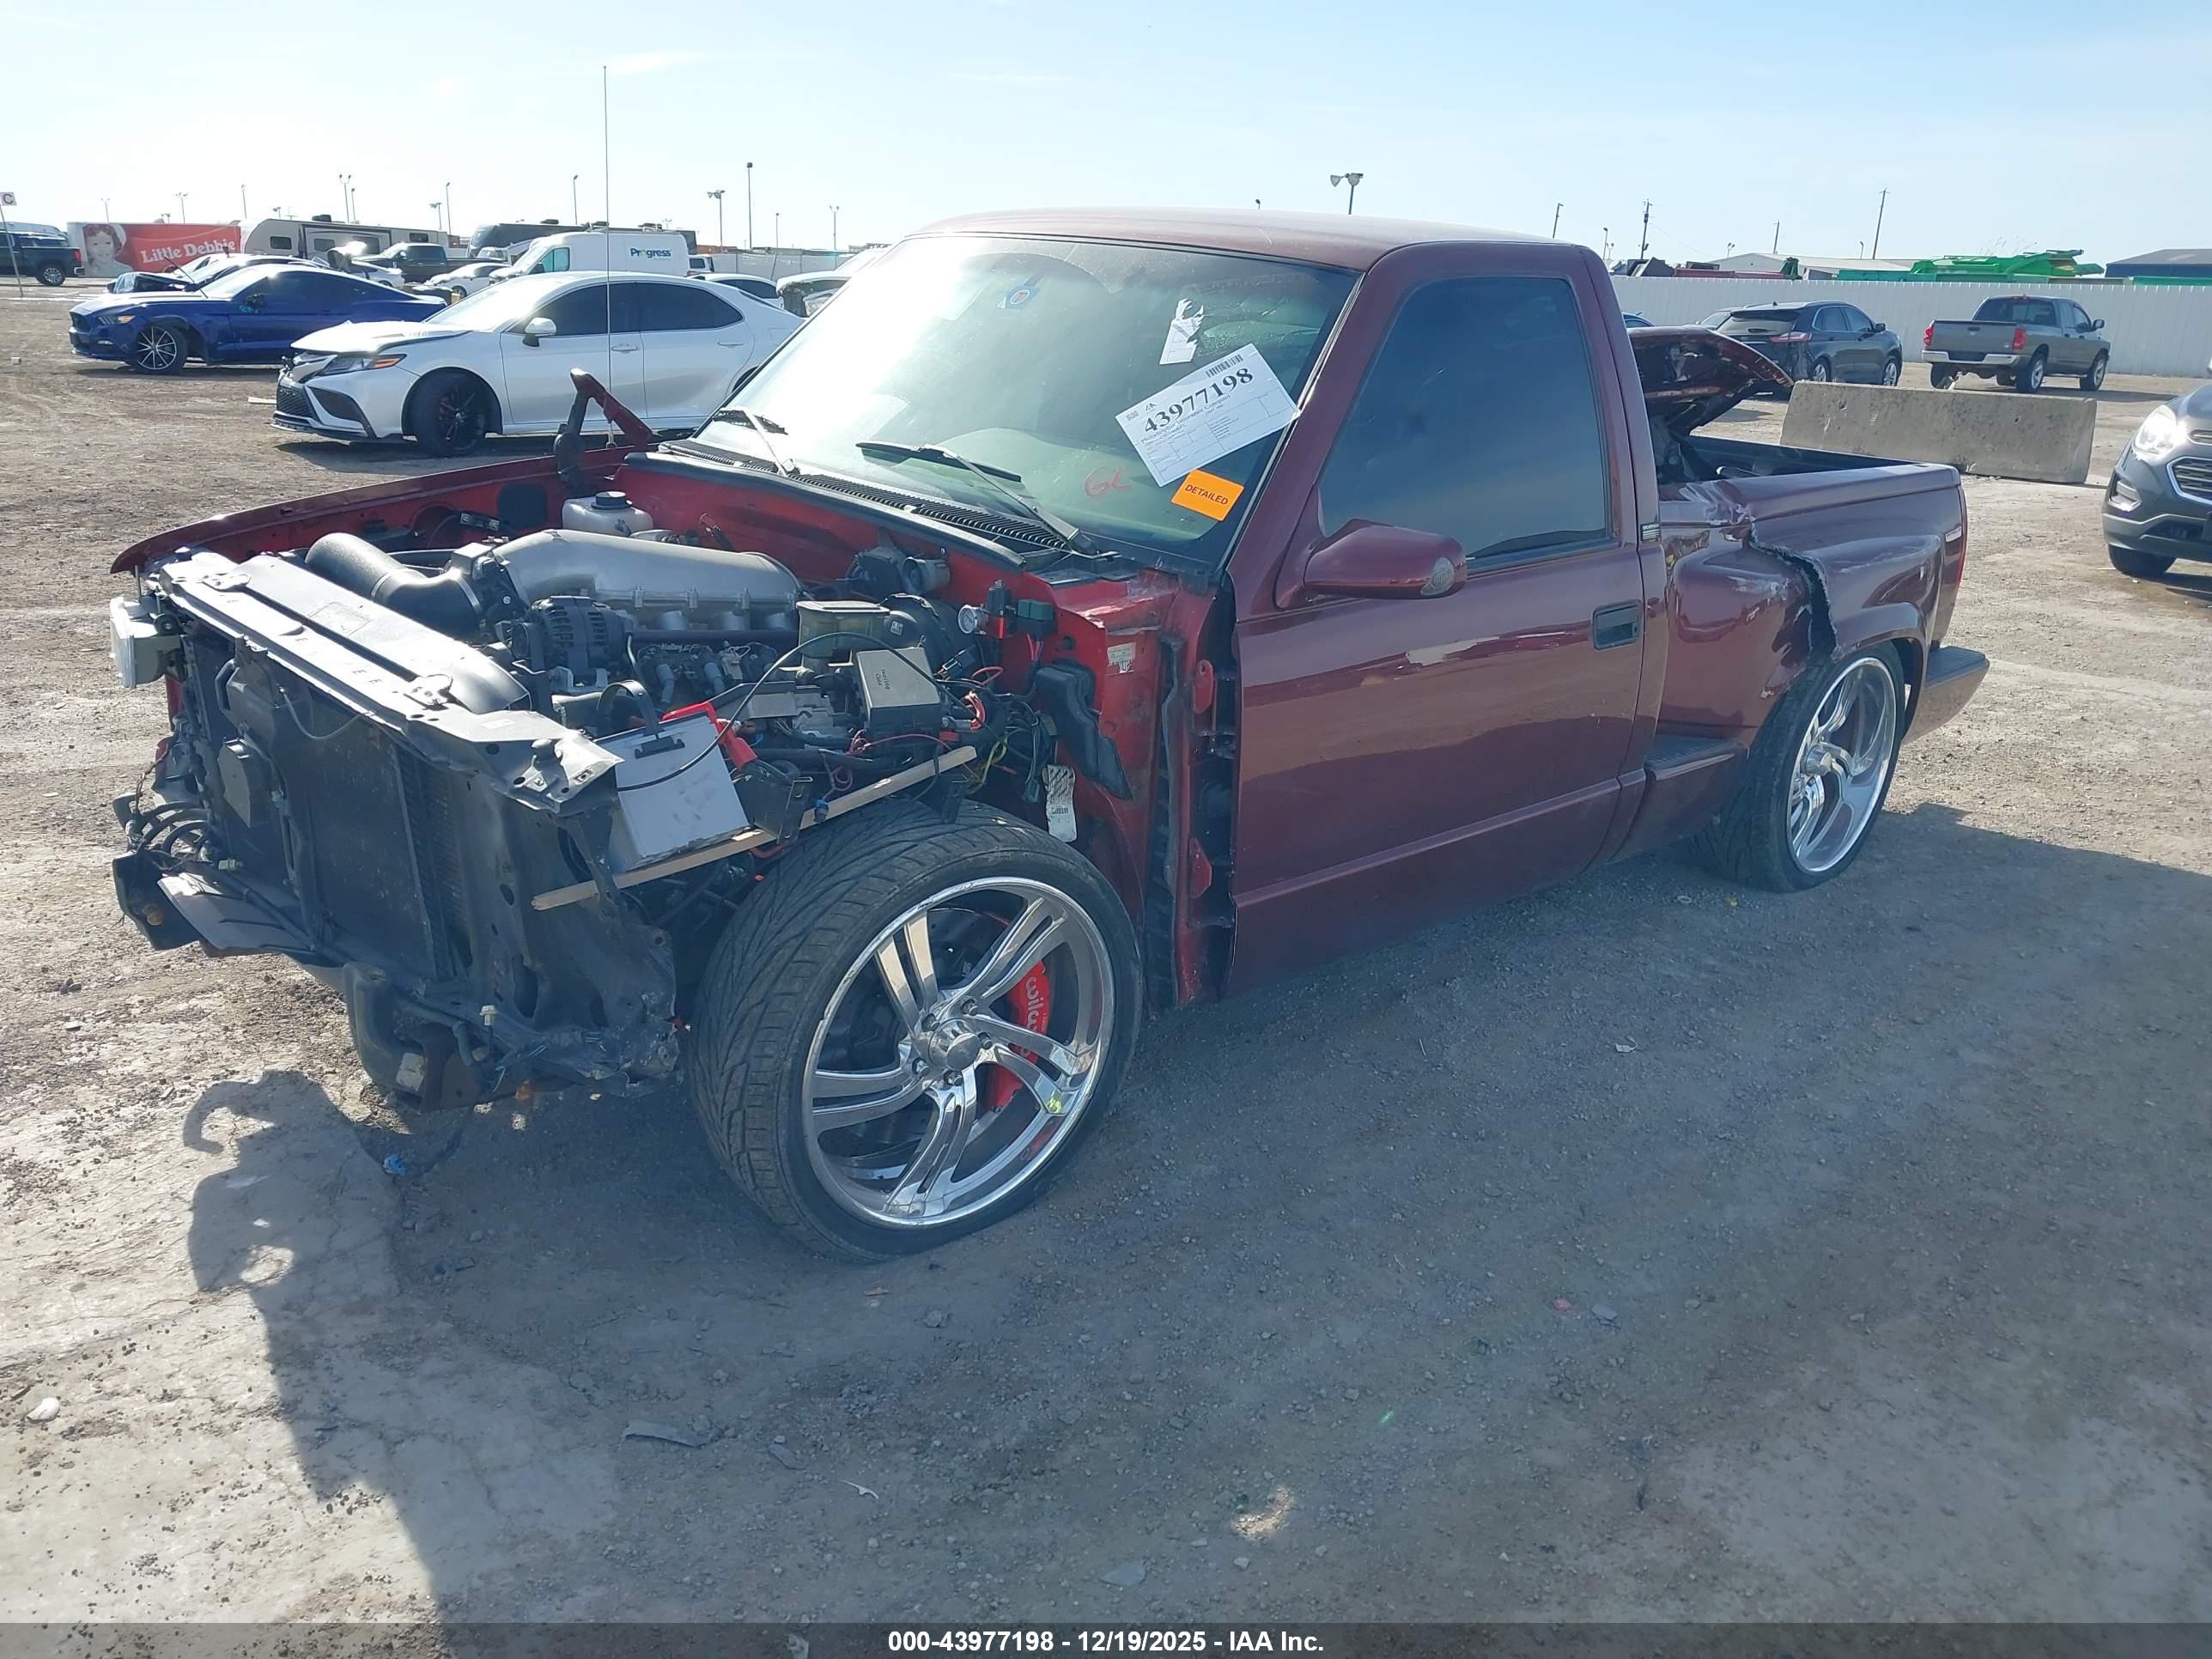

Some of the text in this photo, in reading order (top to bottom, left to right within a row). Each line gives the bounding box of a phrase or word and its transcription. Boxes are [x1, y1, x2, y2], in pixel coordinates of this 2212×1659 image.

[3, 193, 14, 204] C
[140, 239, 236, 264] Little Debbie
[1145, 368, 1254, 434] 43977198
[1185, 484, 1229, 505] DETAILED
